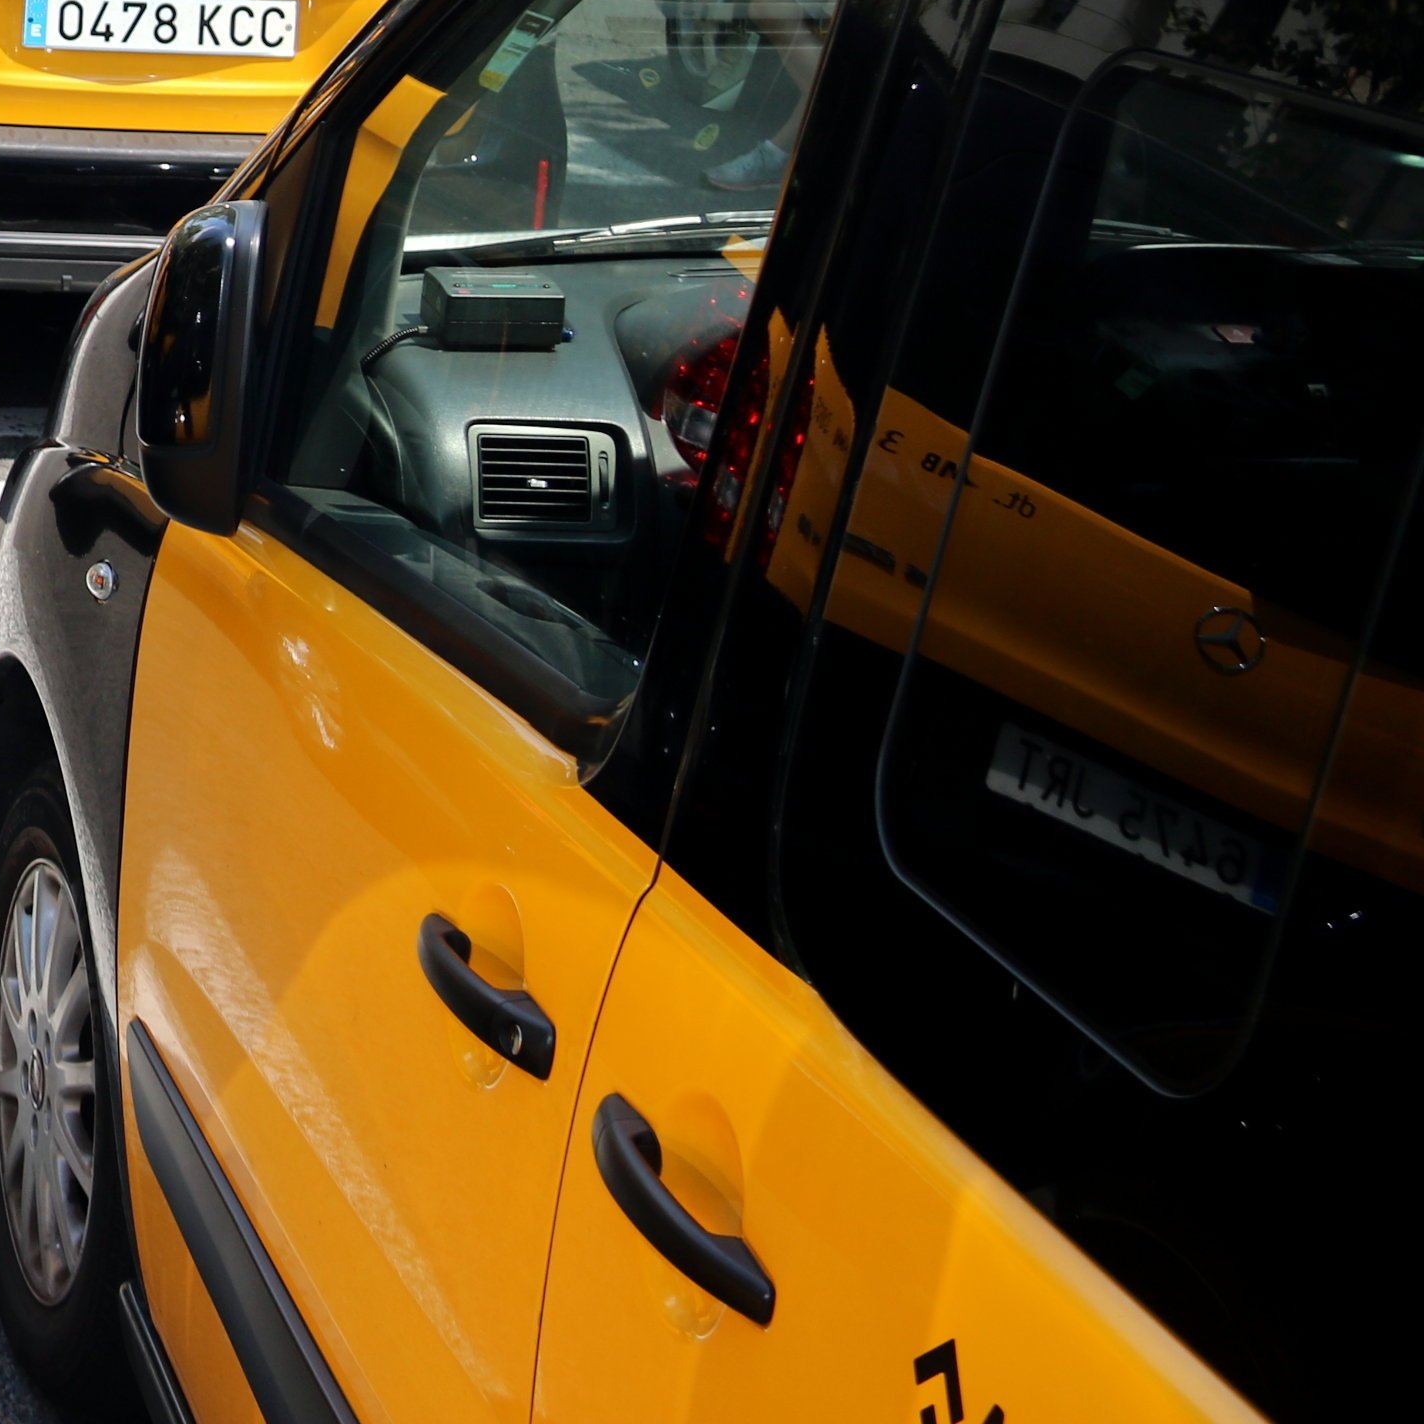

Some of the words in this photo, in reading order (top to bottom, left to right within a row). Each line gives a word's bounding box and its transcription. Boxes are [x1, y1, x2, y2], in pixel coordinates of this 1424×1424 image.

[29, 24, 42, 37] E
[58, 0, 178, 45] 0478
[197, 5, 286, 48] KCC
